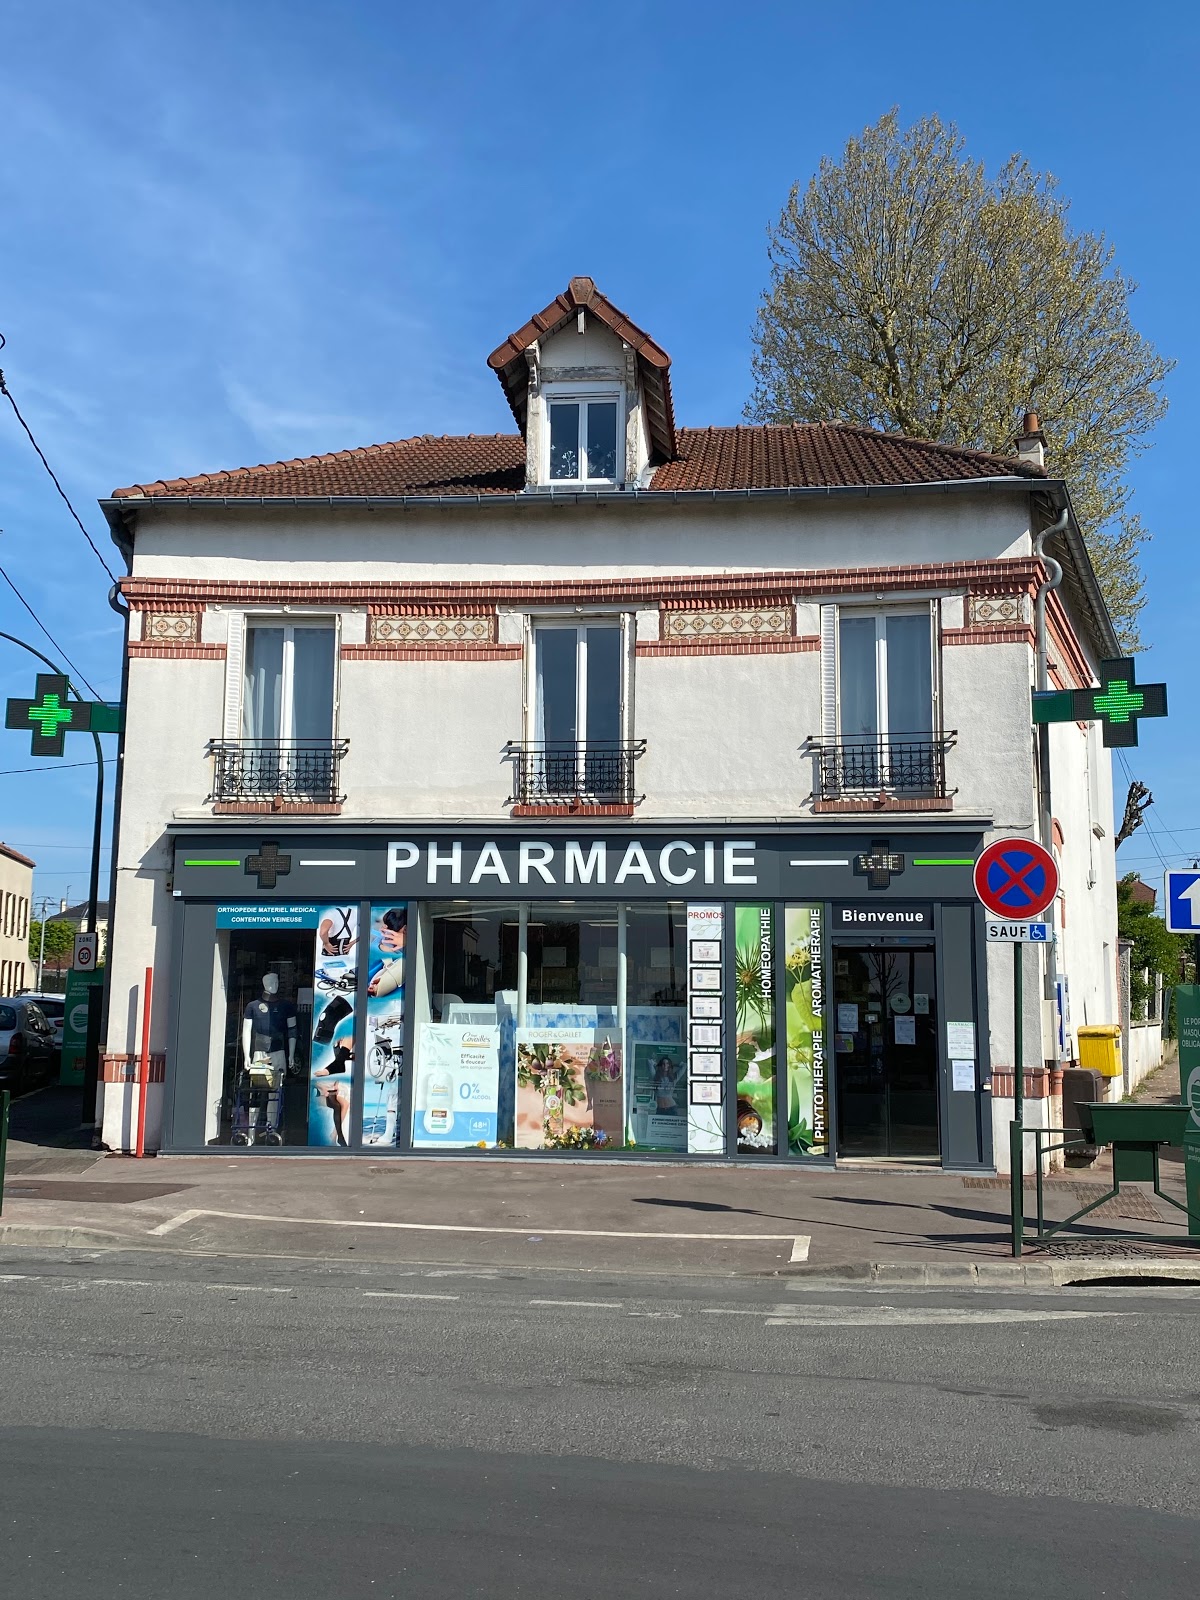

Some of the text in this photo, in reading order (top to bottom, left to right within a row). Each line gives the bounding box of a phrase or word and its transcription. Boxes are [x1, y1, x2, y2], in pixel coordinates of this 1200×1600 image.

[386, 840, 758, 885] PHARMACIE
[842, 909, 924, 922] Bienvenue
[989, 925, 1028, 938] SAUF
[80, 952, 89, 960] 30
[760, 908, 771, 999] HOMEOPATHIE
[810, 908, 823, 1018] AROMATHERAPIE
[1183, 1017, 1190, 1025] LE
[459, 1082, 480, 1100] 0%
[812, 1030, 825, 1139] PHYTOTHERAPIE
[472, 1121, 488, 1129] 48H
